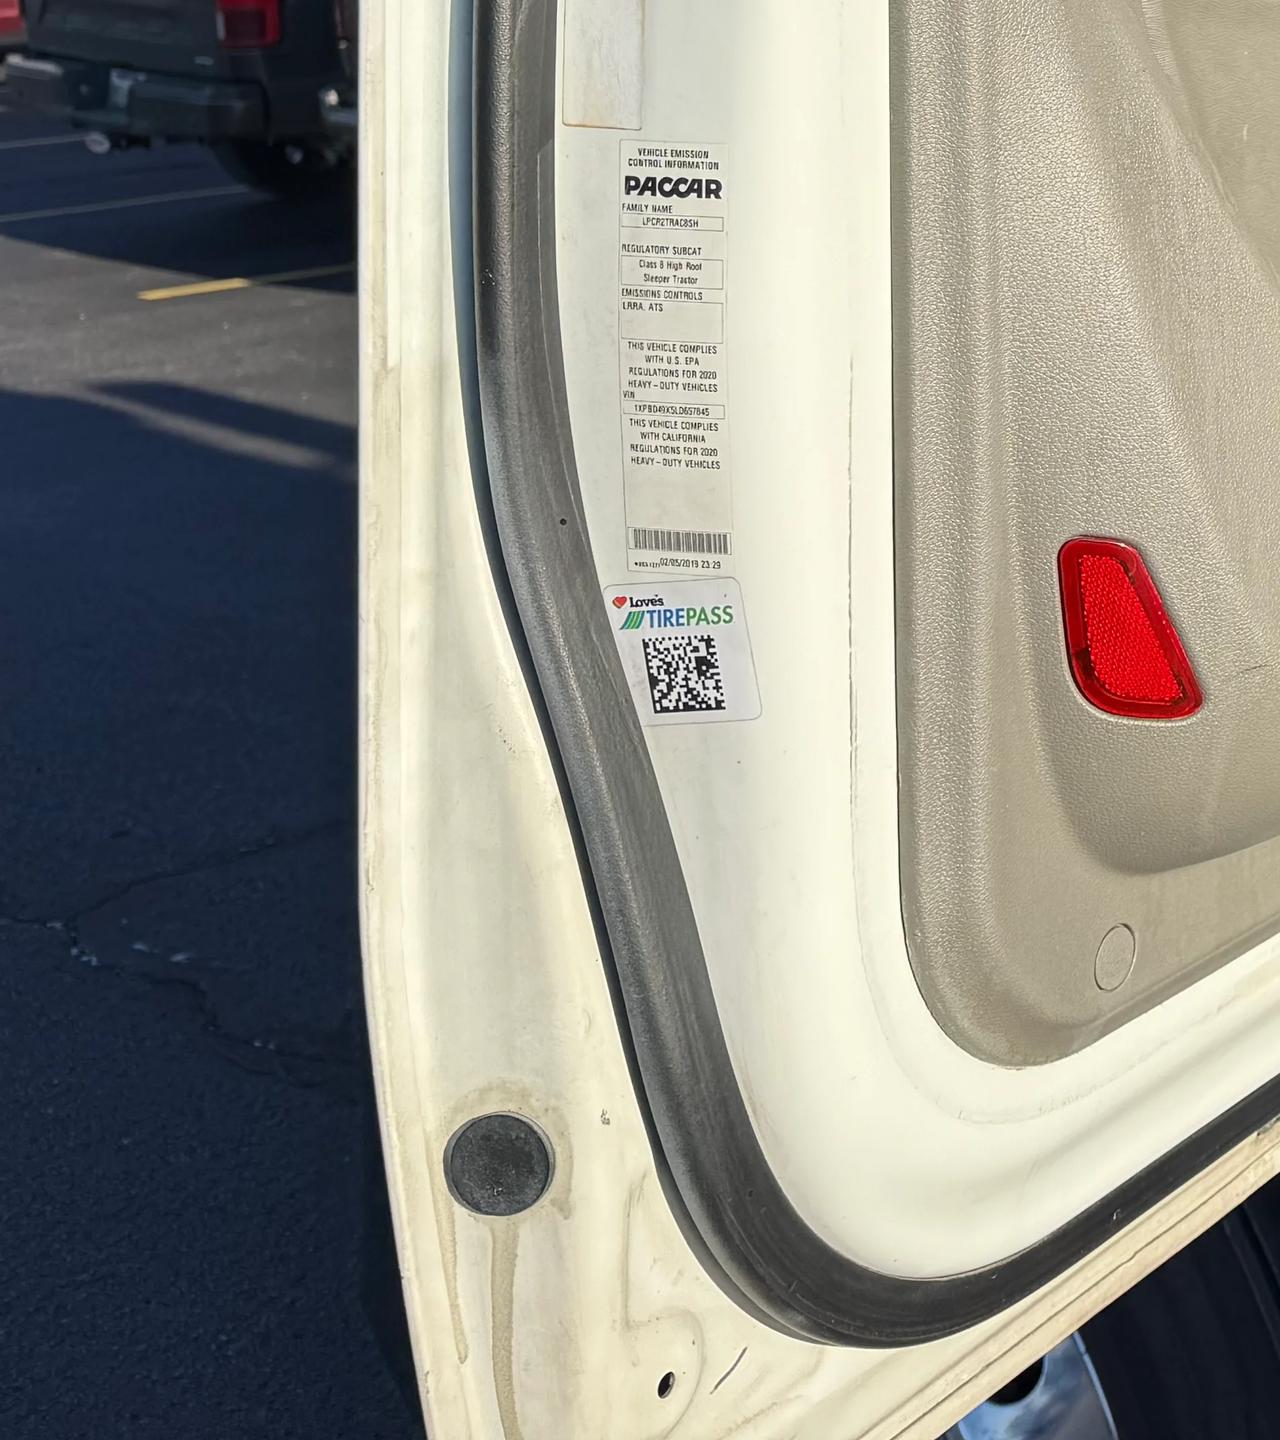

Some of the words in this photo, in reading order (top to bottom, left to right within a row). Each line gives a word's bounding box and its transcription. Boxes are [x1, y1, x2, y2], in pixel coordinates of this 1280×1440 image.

[638, 148, 668, 157] VEHICLE
[671, 149, 709, 159] EMISSION
[628, 159, 662, 168] CONTROL
[665, 160, 719, 170] INFORMATION
[625, 176, 722, 199] PACCAR
[622, 203, 649, 212] FAMILY
[652, 205, 673, 213] NAME
[622, 244, 670, 254] REGULATORY
[672, 247, 702, 256] SUBCAT
[639, 260, 657, 269] Class
[660, 260, 664, 269] 8
[667, 261, 682, 271] High
[686, 262, 702, 271] Roof
[644, 274, 670, 283] Sleeper
[673, 275, 698, 284] Tractor
[622, 288, 660, 298] EMISSIONS
[664, 291, 703, 300] CONTROLS
[649, 303, 663, 312] ATS
[628, 341, 644, 350] THIS
[647, 342, 676, 352] VEHICLE
[679, 344, 717, 354] COMPLIES
[645, 355, 663, 363] WITH
[667, 356, 681, 365] U.S.
[685, 357, 699, 366] EPA
[629, 367, 679, 378] REGULATIONS
[682, 370, 696, 378] FOR
[700, 371, 717, 379] 2020
[682, 383, 718, 392] VEHICLES
[623, 391, 634, 399] VIN
[630, 418, 645, 427] THIS
[648, 420, 678, 429] VEHICLE
[681, 421, 719, 431] COMPLIES
[640, 432, 659, 440] WITH
[662, 433, 705, 443] CALIFORNIA
[630, 444, 680, 455] REGULATIONS
[684, 447, 698, 455] FOR
[701, 448, 718, 456] 2020
[685, 460, 720, 470] VEHICLES
[629, 596, 664, 608] Love's
[646, 605, 733, 629] TIREPASS
